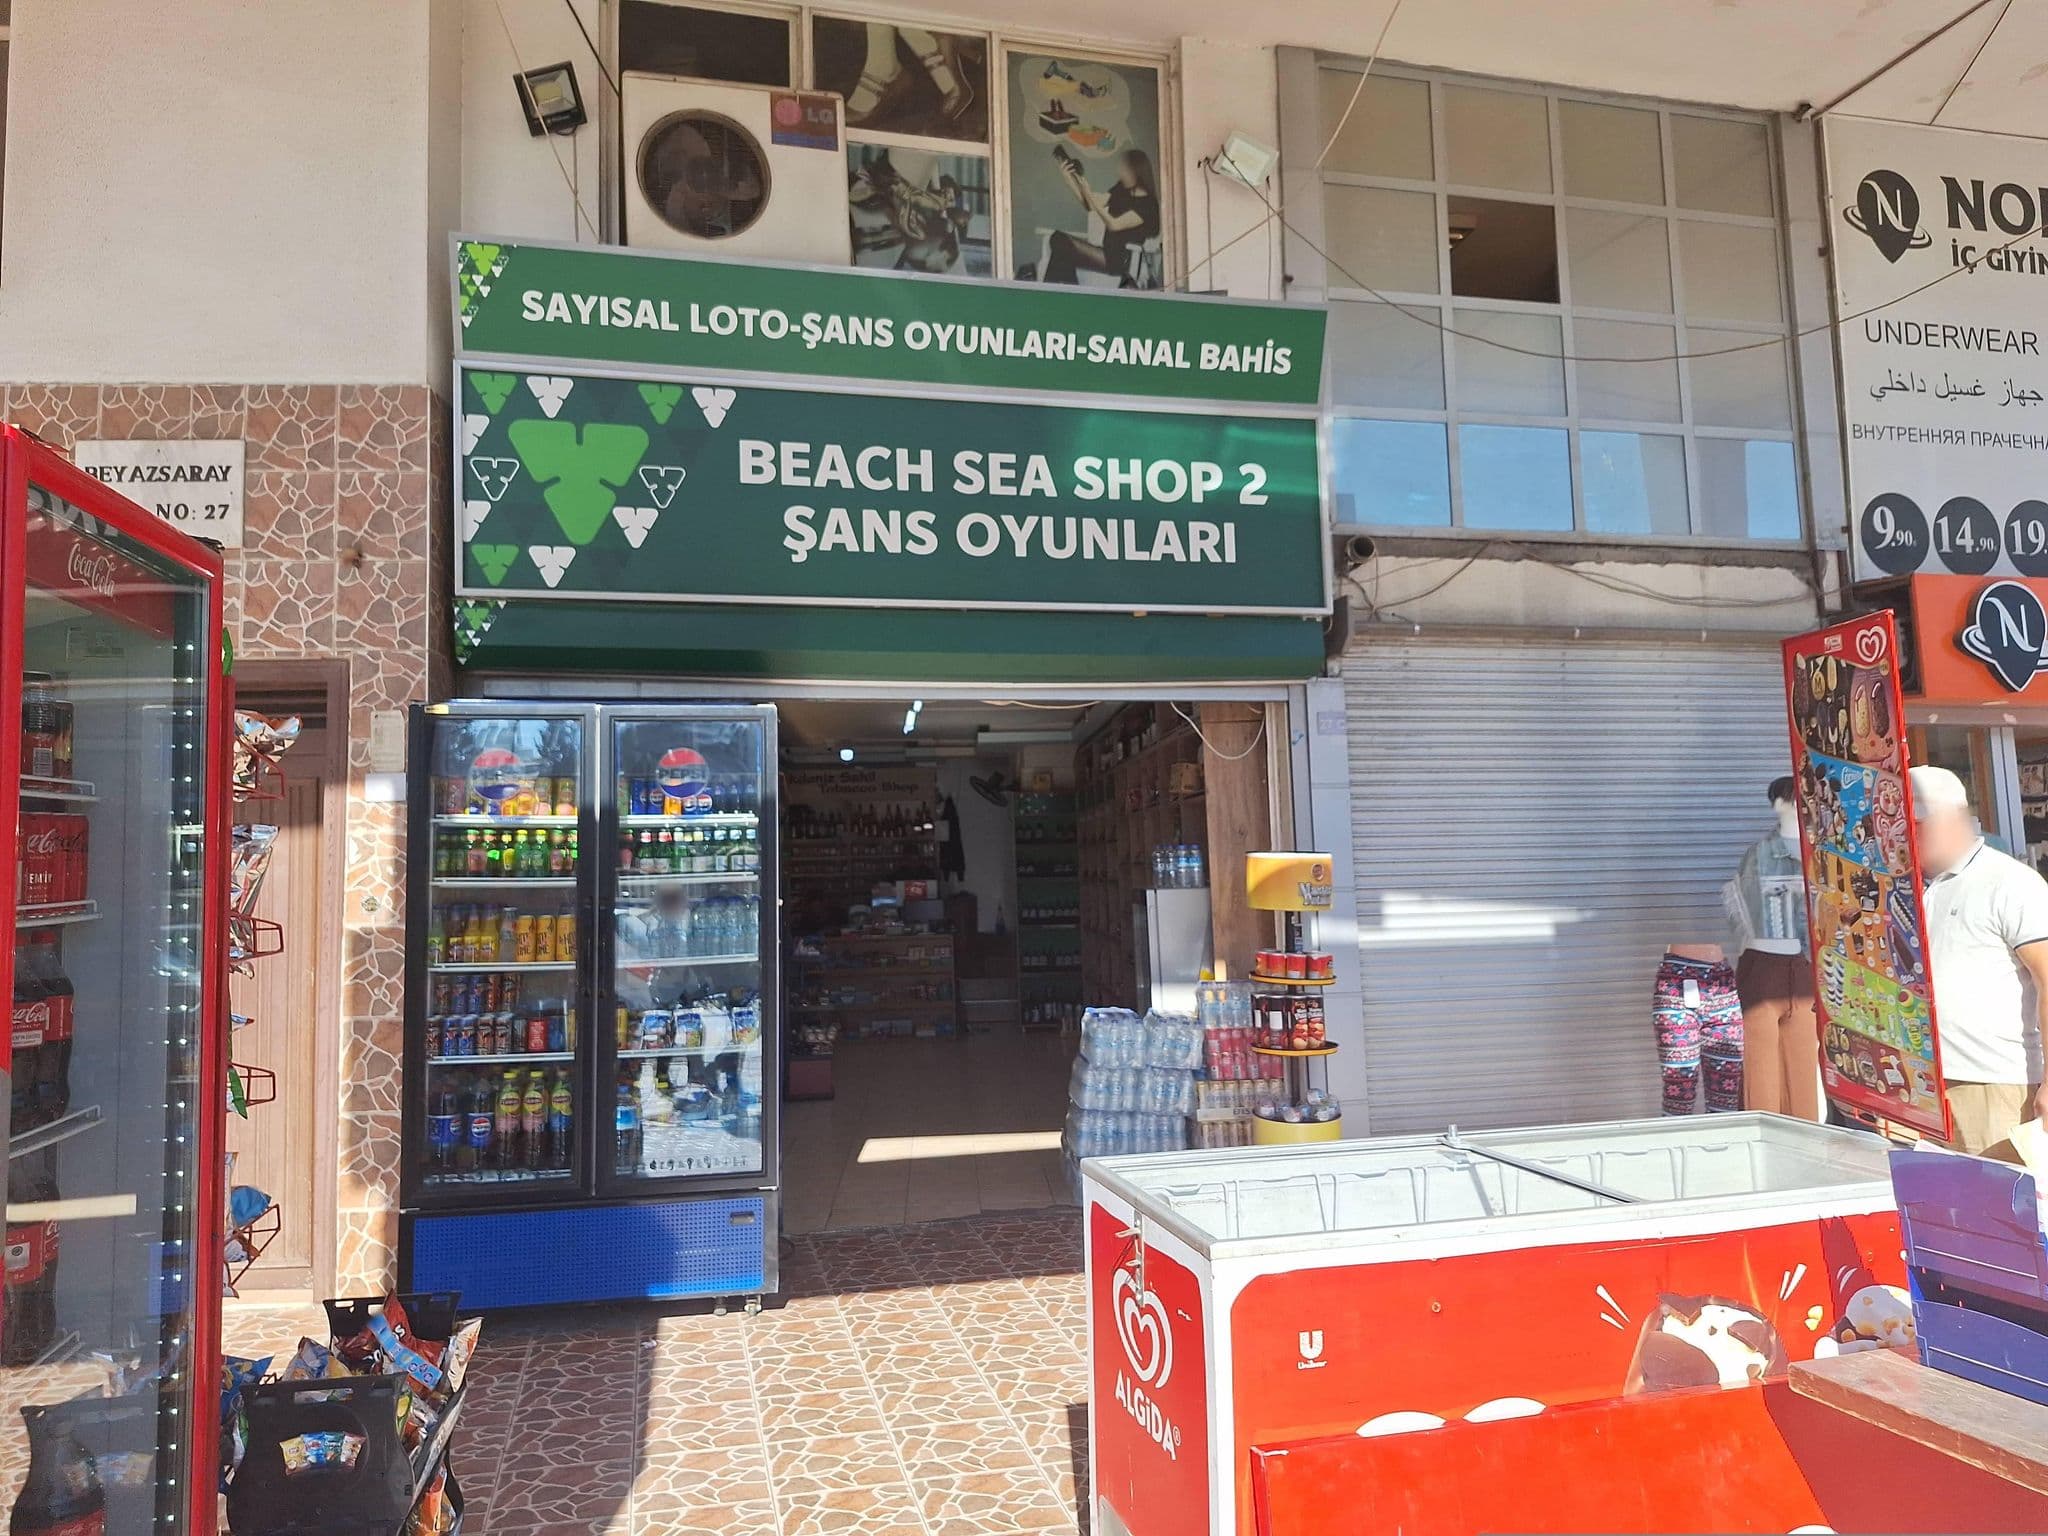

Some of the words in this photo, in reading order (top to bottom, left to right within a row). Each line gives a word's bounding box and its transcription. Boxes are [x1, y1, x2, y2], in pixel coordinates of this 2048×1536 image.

[1940, 176, 2048, 238] NO
[1951, 238, 1977, 274] İÇ
[522, 290, 680, 331] SAYISAL
[690, 303, 894, 350] LOTO-ŞANS
[904, 321, 1191, 369] OYUNLARI-SANAL
[1199, 339, 1292, 375] BAHİS
[1864, 318, 2040, 356] UNDERWEAR
[1870, 368, 1927, 402] داخلي
[1935, 372, 1986, 402] غسيل
[1998, 378, 2044, 407] جهاز
[1852, 423, 1966, 447] ВНУТРЕННЯЯ
[739, 439, 934, 492] BEACH
[953, 450, 1058, 497] SEA
[1073, 455, 1224, 503] SHOP
[1238, 462, 1269, 506] 2
[204, 503, 230, 520] 27
[783, 505, 938, 563] ŞANS
[956, 512, 1236, 563] OYUNLARI
[1936, 515, 1995, 554] 14.90
[67, 543, 117, 598] Coca-Cola
